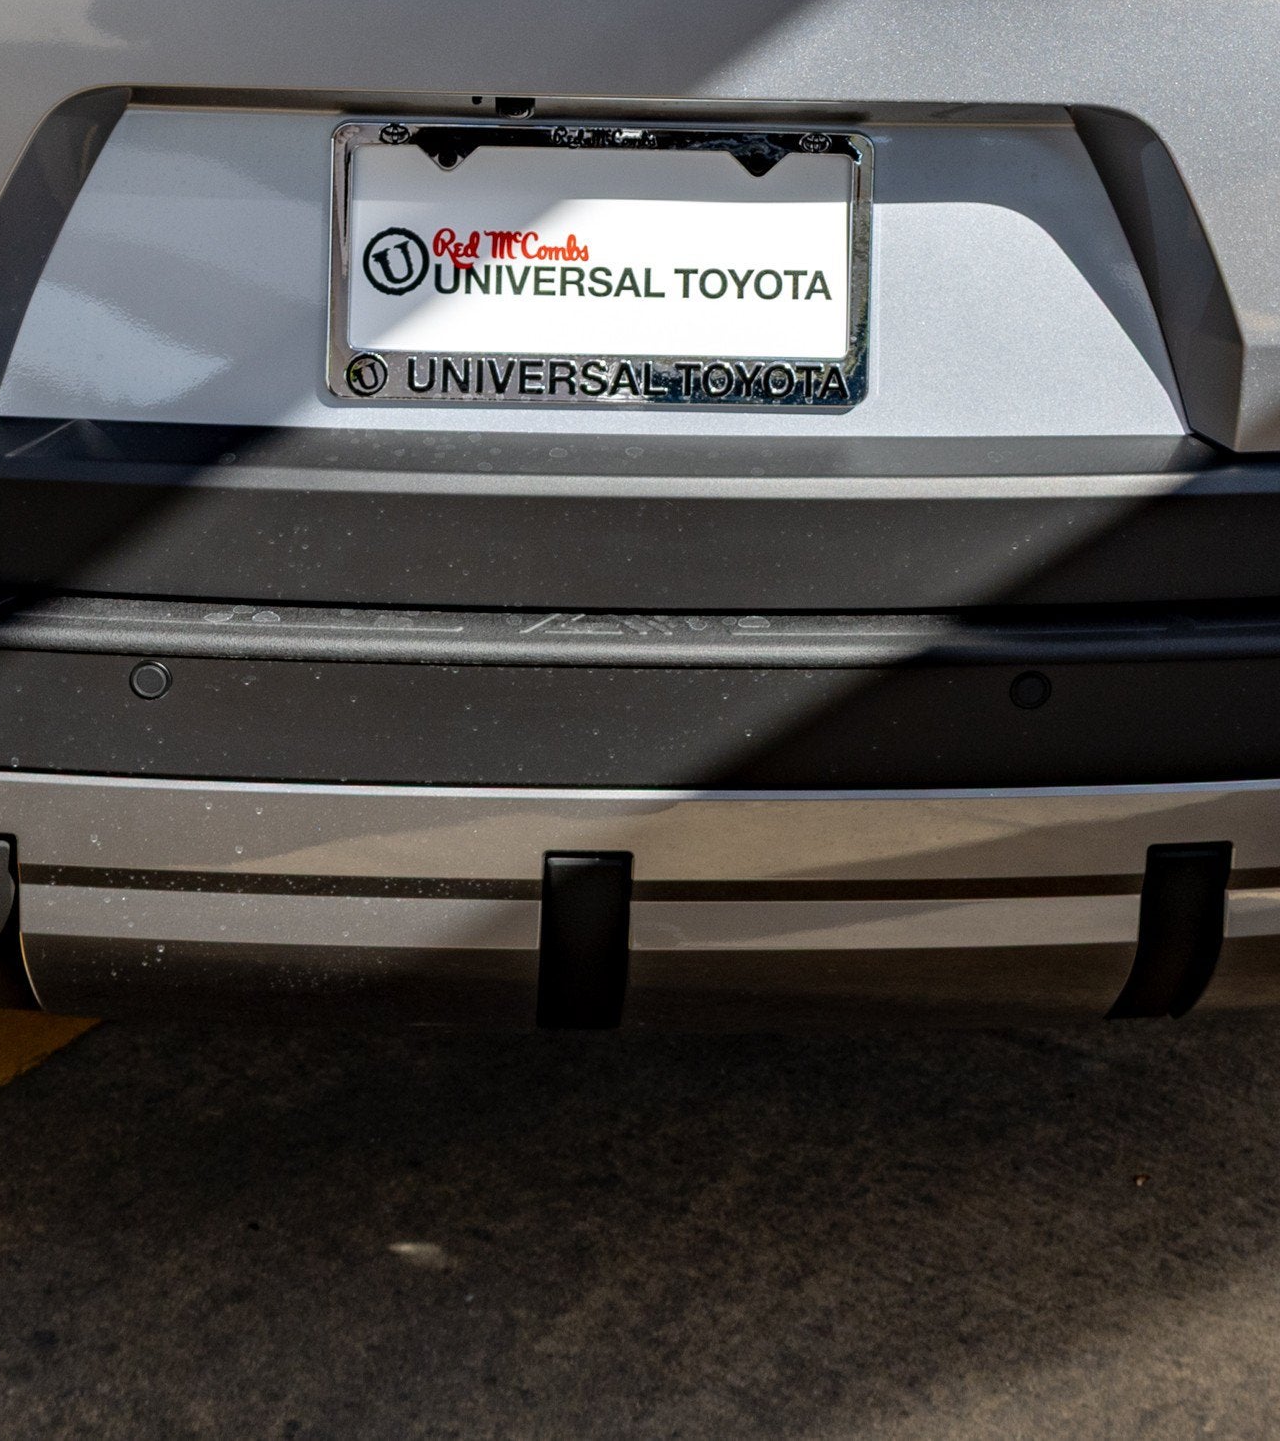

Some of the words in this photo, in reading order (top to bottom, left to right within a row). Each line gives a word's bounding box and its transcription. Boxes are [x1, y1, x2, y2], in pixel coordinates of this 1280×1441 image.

[432, 227, 480, 269] Red
[484, 230, 589, 262] McCombs
[434, 264, 666, 298] UNIVERSAL
[675, 268, 833, 301] TOYOTA
[406, 355, 668, 397] UNIVERSAL
[674, 360, 850, 400] TOYOTA
